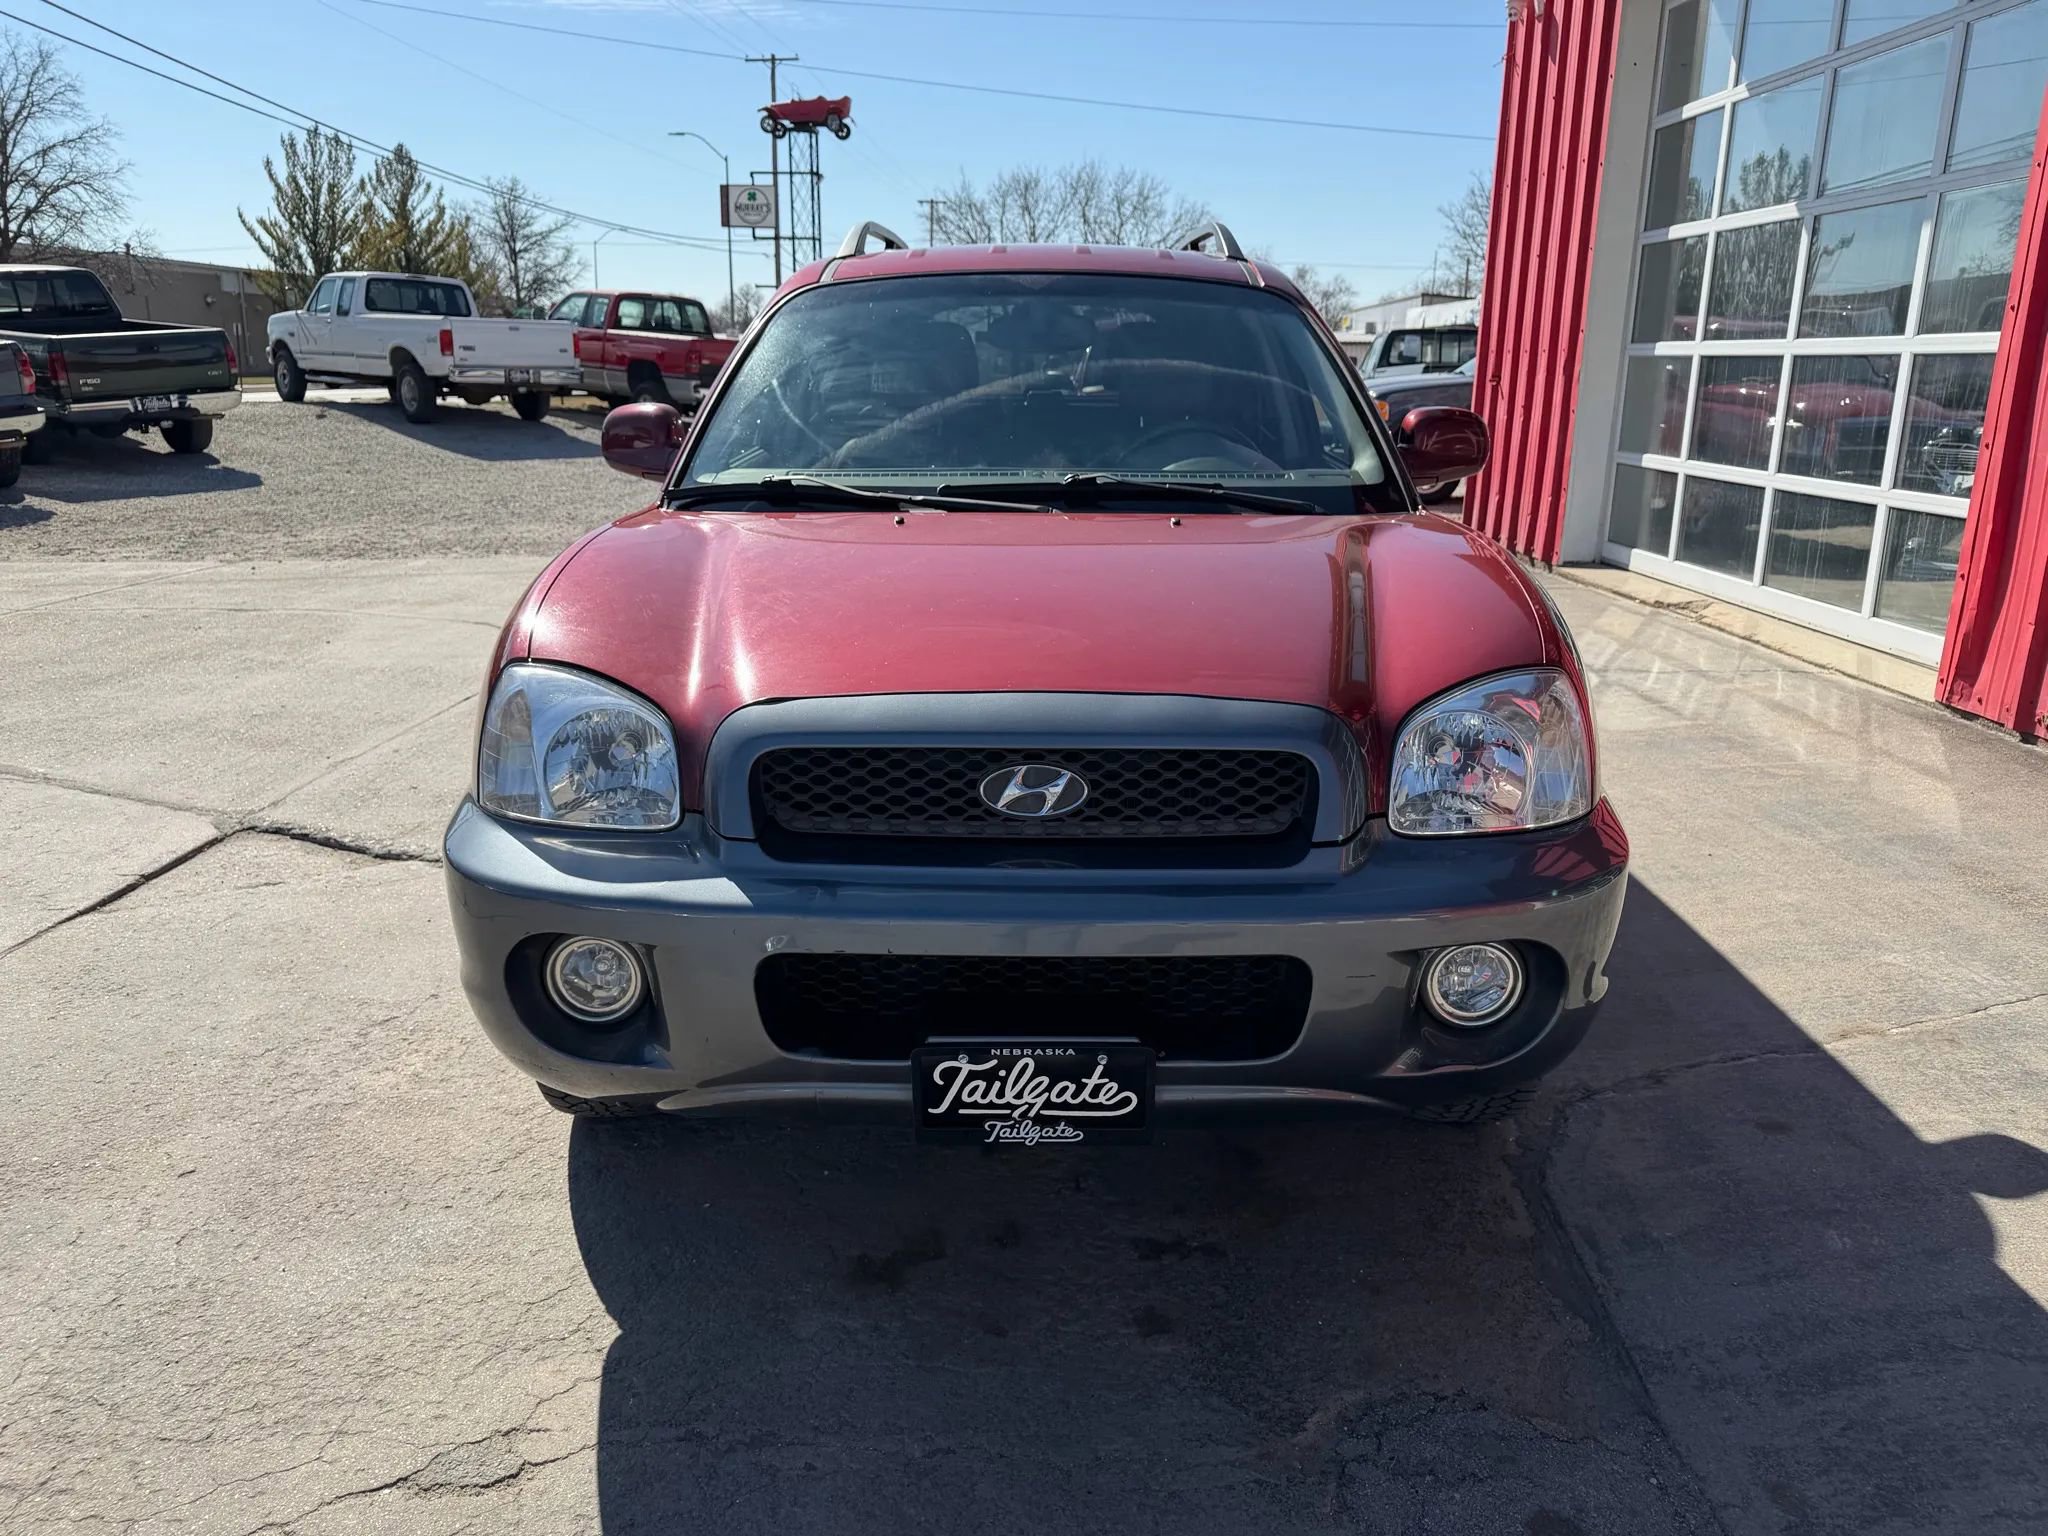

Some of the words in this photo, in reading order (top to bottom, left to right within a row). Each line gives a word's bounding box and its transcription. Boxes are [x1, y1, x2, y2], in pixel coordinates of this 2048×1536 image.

[990, 1048, 1076, 1056] NEBRASKA
[928, 1057, 1138, 1120] Tailgate
[984, 1120, 1084, 1146] Tailgate
